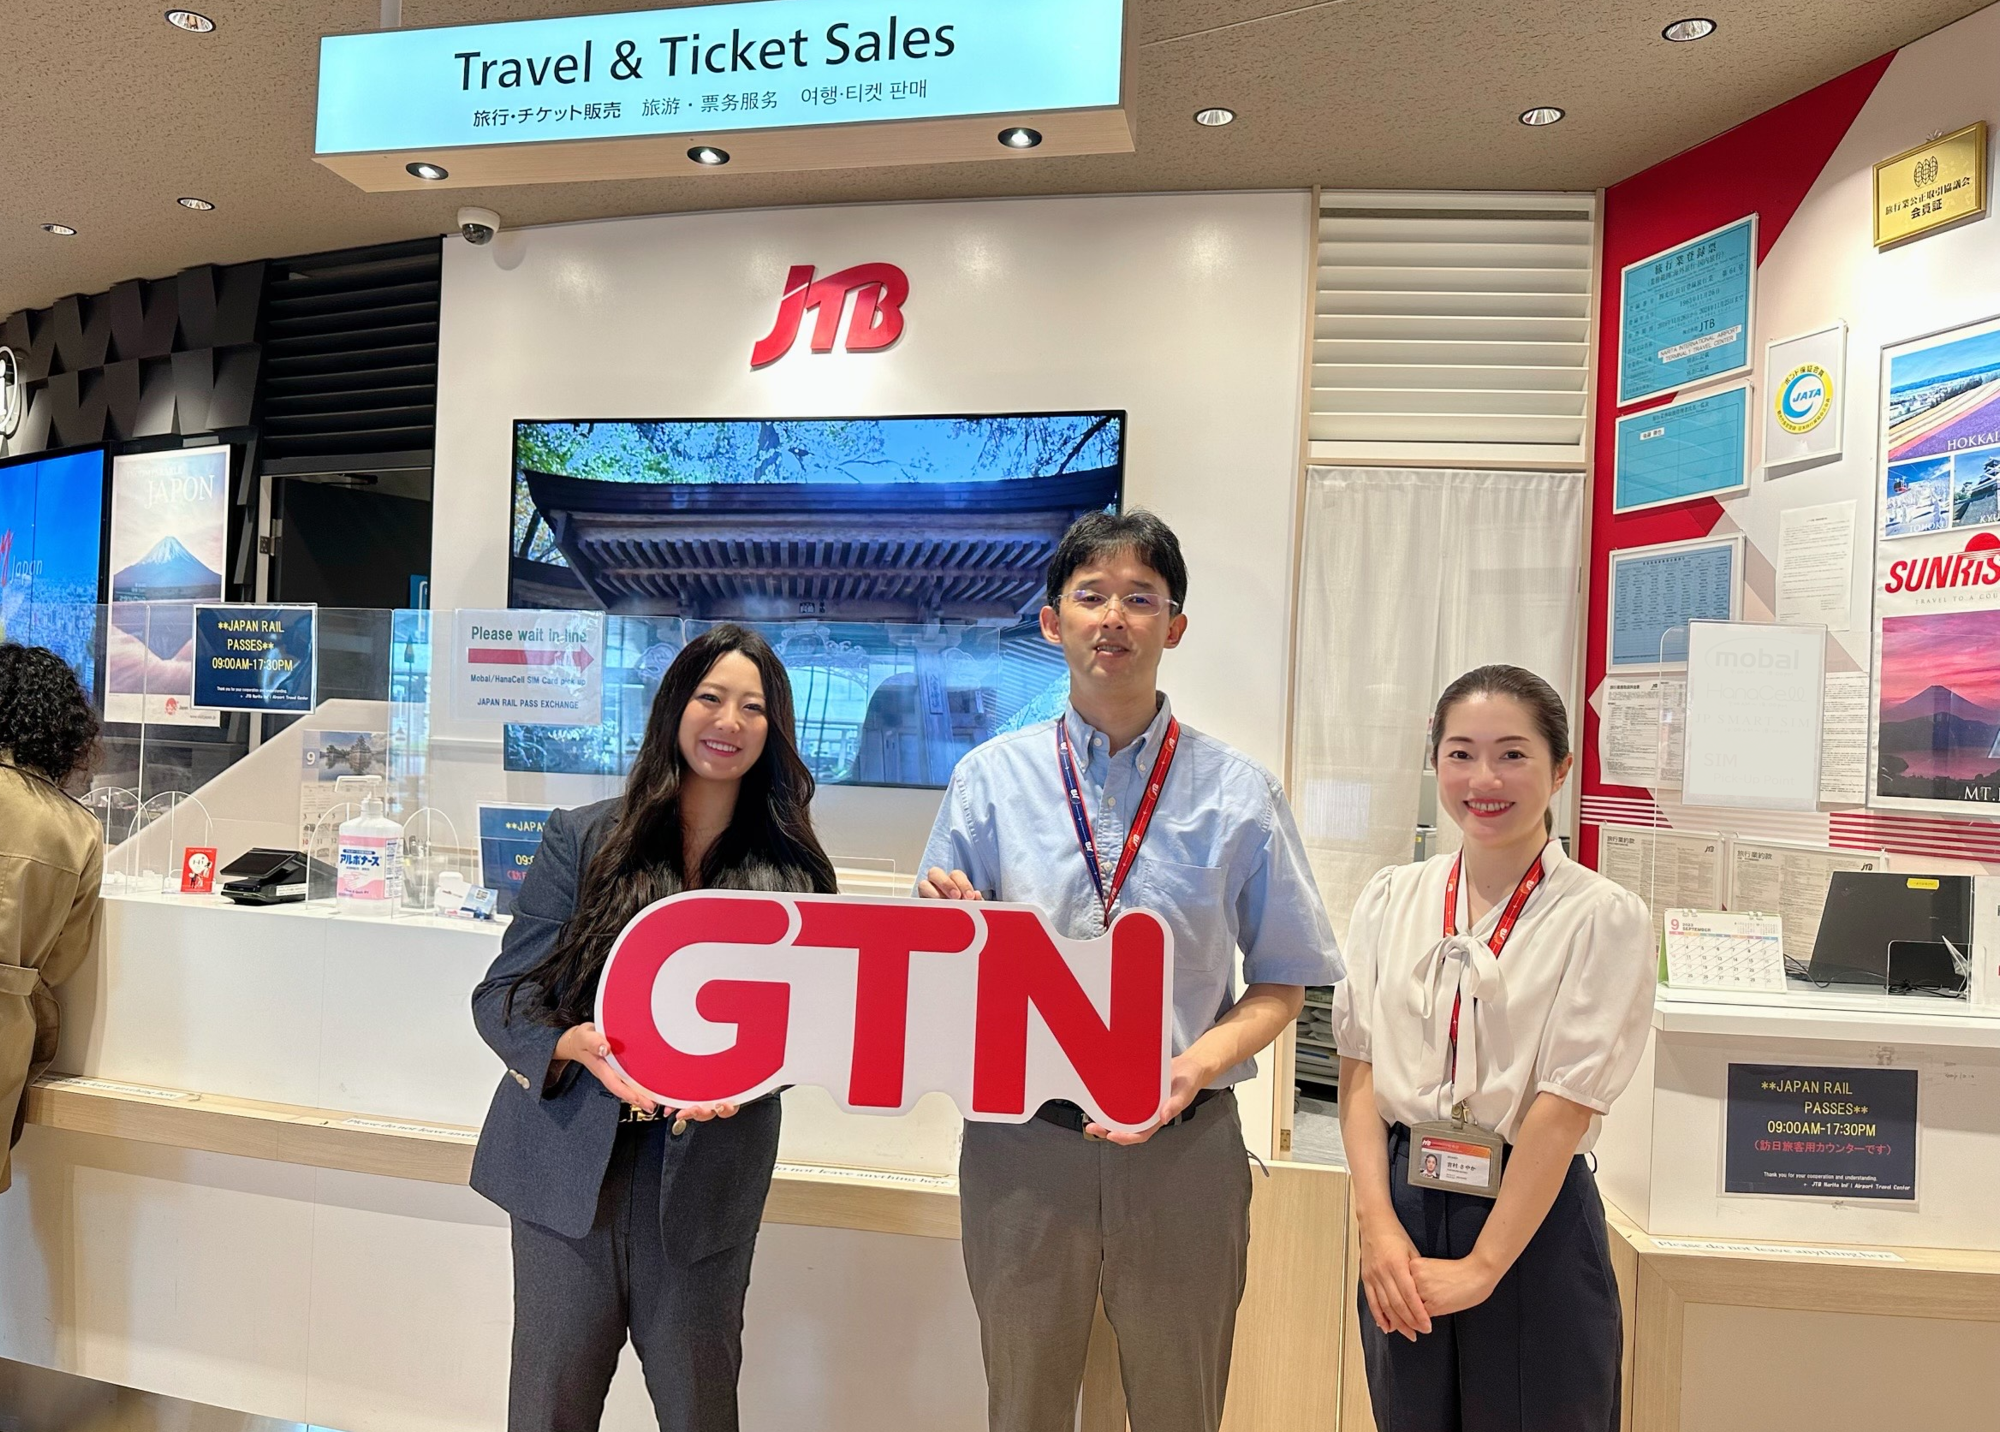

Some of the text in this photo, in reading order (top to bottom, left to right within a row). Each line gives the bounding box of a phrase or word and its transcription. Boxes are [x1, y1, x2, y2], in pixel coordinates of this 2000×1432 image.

[454, 15, 956, 91] Travel & Ticket Sales
[889, 79, 928, 100] 판매
[1885, 176, 1970, 215] 旅行業公正取引協議会
[1911, 198, 1942, 219] 会員証
[750, 262, 909, 369] JTB
[1698, 319, 1715, 332] JTB
[1792, 388, 1821, 402] JATA
[144, 474, 215, 509] JAPON
[1909, 520, 1949, 533] TOHOKU
[9, 555, 43, 585] Japan
[1915, 596, 1947, 605] TRAVEL
[262, 620, 284, 632] RAIL
[471, 626, 587, 642] Please wait in line
[212, 657, 293, 671] 09:00AM-17:30PM
[1715, 648, 1800, 670] mobal
[470, 674, 525, 684] Mobal/HanaCell
[527, 675, 539, 684] SIM
[541, 676, 558, 685] Card
[576, 679, 586, 687] up
[1706, 682, 1807, 703] HanaCell
[477, 698, 579, 709] JAPAN RAIL PASS EXCHANGE
[1695, 713, 1811, 729] JP SMART SIM
[306, 751, 316, 765] 9
[1703, 752, 1738, 768] SIM
[1713, 773, 1795, 786] Pick-Up Point
[1964, 786, 2000, 801] MT.
[506, 821, 545, 832] JAPA
[340, 854, 380, 866] アルボナース
[1671, 919, 1679, 930] 9
[602, 896, 1165, 1126] GTN
[1824, 1082, 1853, 1095] RAIL
[1767, 1121, 1876, 1136] 09:00AM-17:30PM
[818, 1168, 854, 1177] leave
[857, 1173, 916, 1183] anything
[1807, 1173, 1835, 1181] cooperation
[1657, 1241, 1700, 1249] Please
[1755, 1245, 1793, 1254] leave
[1795, 1248, 1859, 1259] anything
